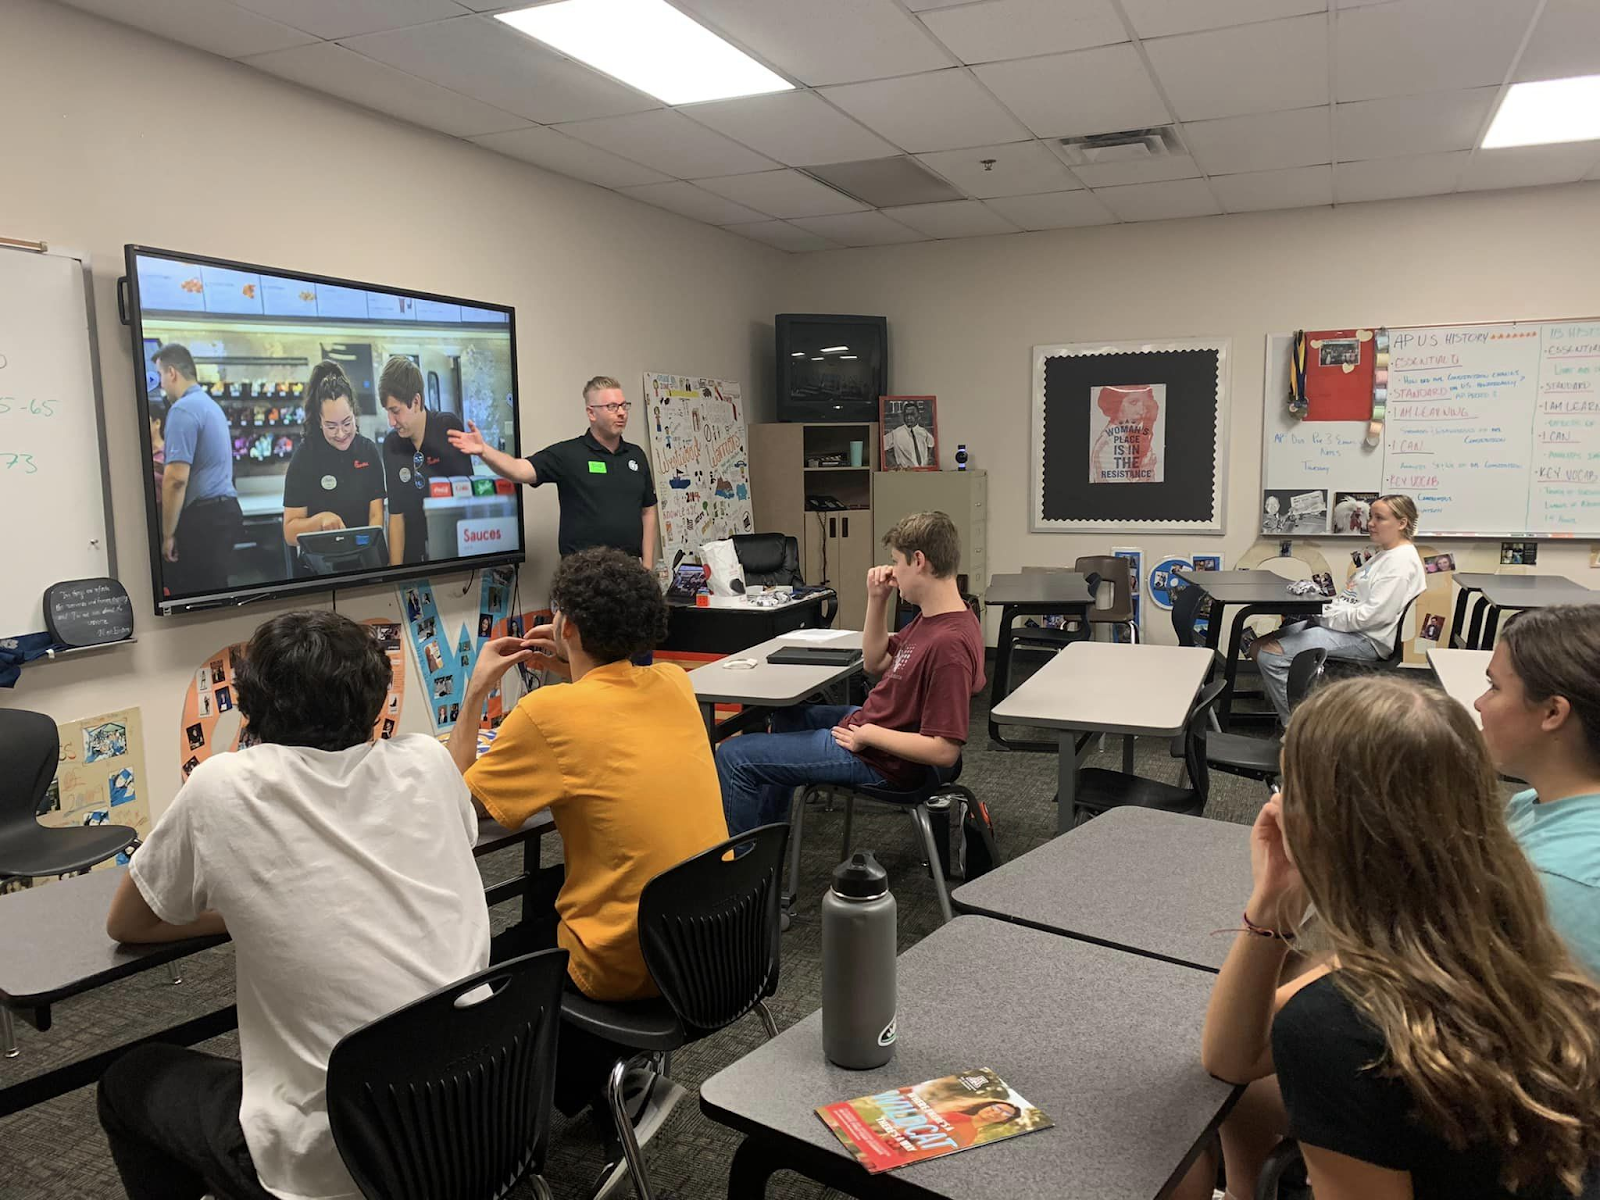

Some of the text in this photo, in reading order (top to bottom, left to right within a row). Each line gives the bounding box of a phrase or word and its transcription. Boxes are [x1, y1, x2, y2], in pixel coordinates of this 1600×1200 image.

[1394, 332, 1489, 350] AP US HISTORY
[1394, 387, 1448, 399] STANDARD
[890, 400, 924, 414] TIE
[1415, 406, 1468, 418] LEARNING
[1105, 425, 1150, 436] WOMAN'S
[1550, 431, 1570, 441] CAN
[1114, 435, 1140, 444] PLACE
[1114, 445, 1140, 455] IS IN
[1400, 440, 1424, 452] CAN
[1114, 457, 1140, 468] THE
[1101, 470, 1151, 478] RESISTANCE
[464, 529, 501, 542] Sauces
[872, 1089, 958, 1149] WILDCAT
